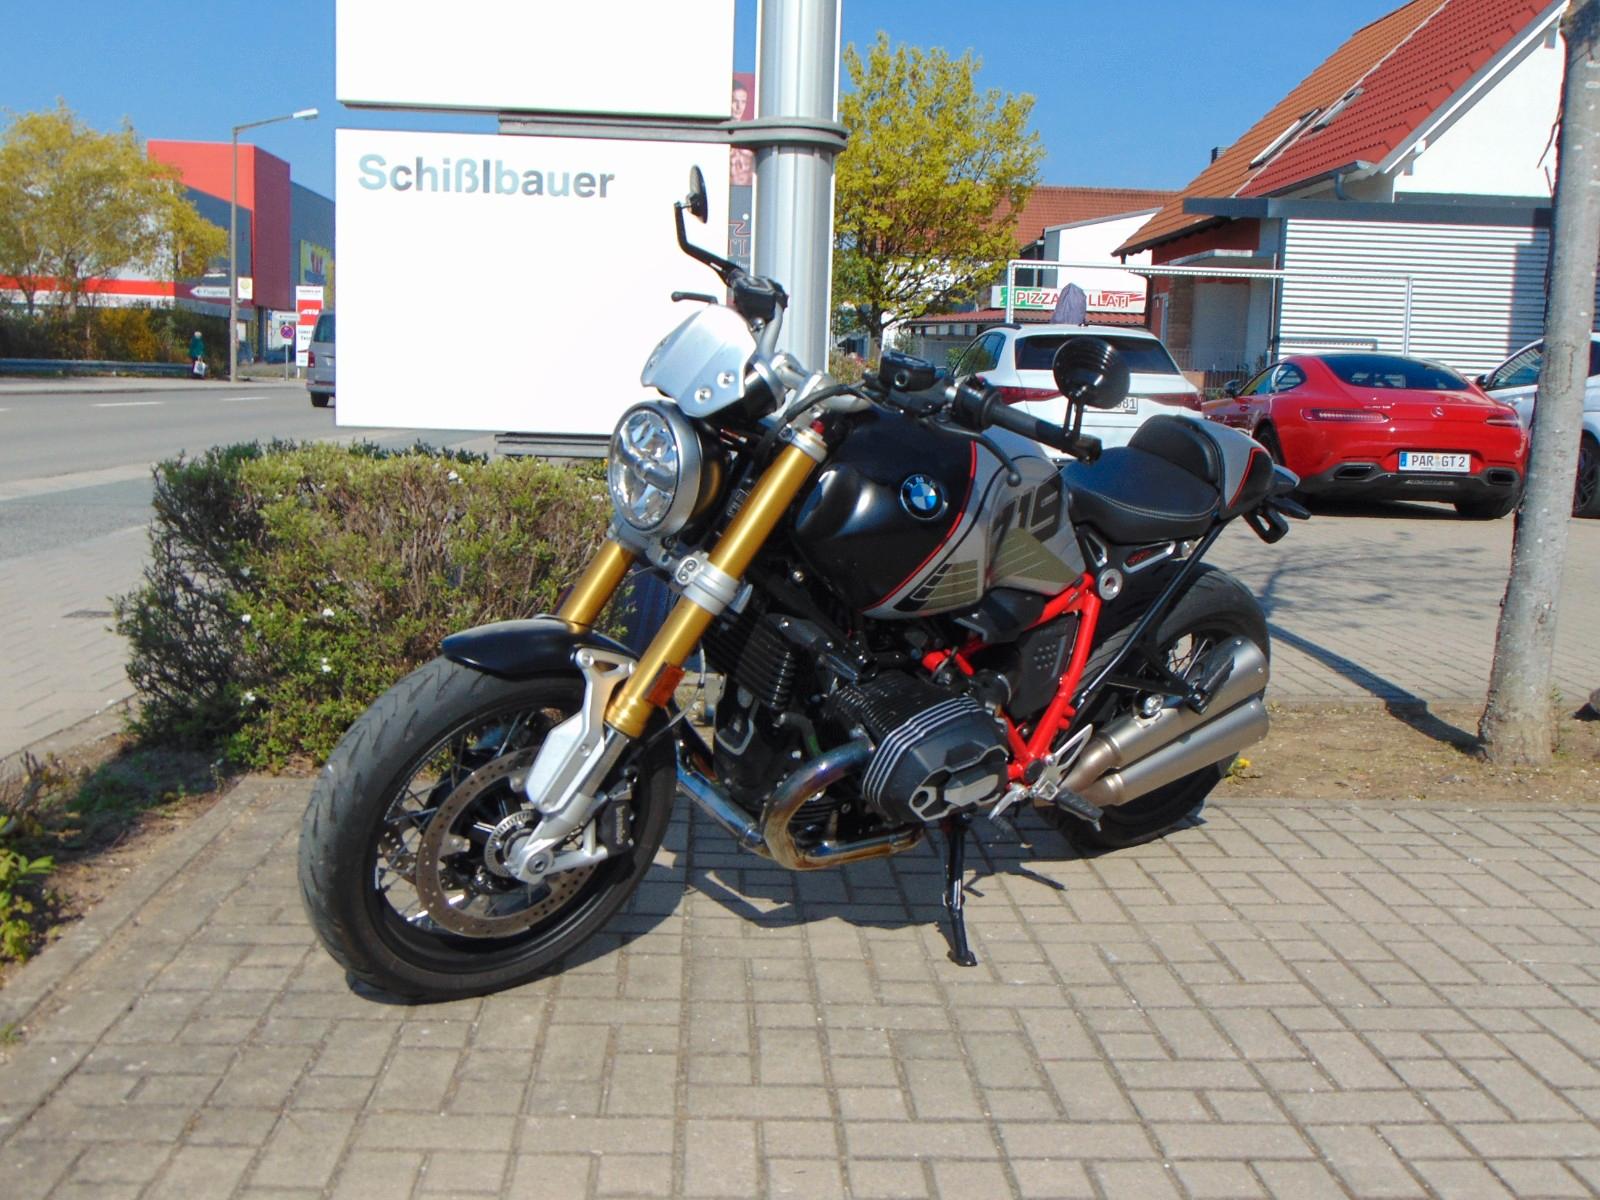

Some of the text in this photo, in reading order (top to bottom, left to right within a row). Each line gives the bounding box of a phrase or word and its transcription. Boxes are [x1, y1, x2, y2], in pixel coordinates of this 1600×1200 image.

[358, 153, 615, 198] Schißlbauer
[1016, 291, 1130, 308] PIZZA LLATI
[1411, 454, 1466, 468] PAR GT 2
